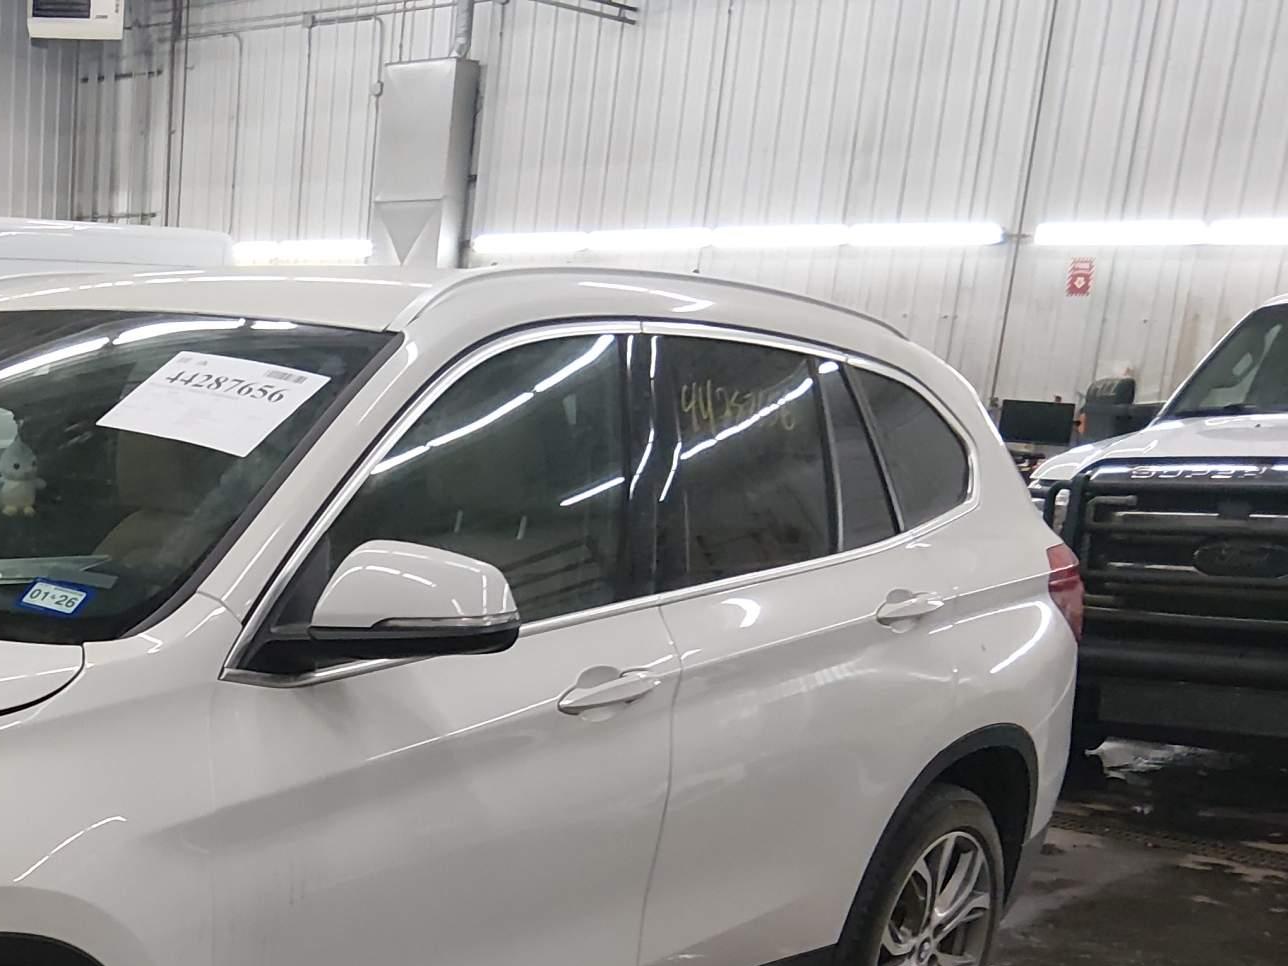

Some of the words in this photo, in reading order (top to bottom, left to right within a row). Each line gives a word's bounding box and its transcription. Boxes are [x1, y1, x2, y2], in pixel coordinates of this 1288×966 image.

[165, 370, 289, 404] 44287656
[29, 588, 50, 601] 01
[55, 595, 79, 608] 26
